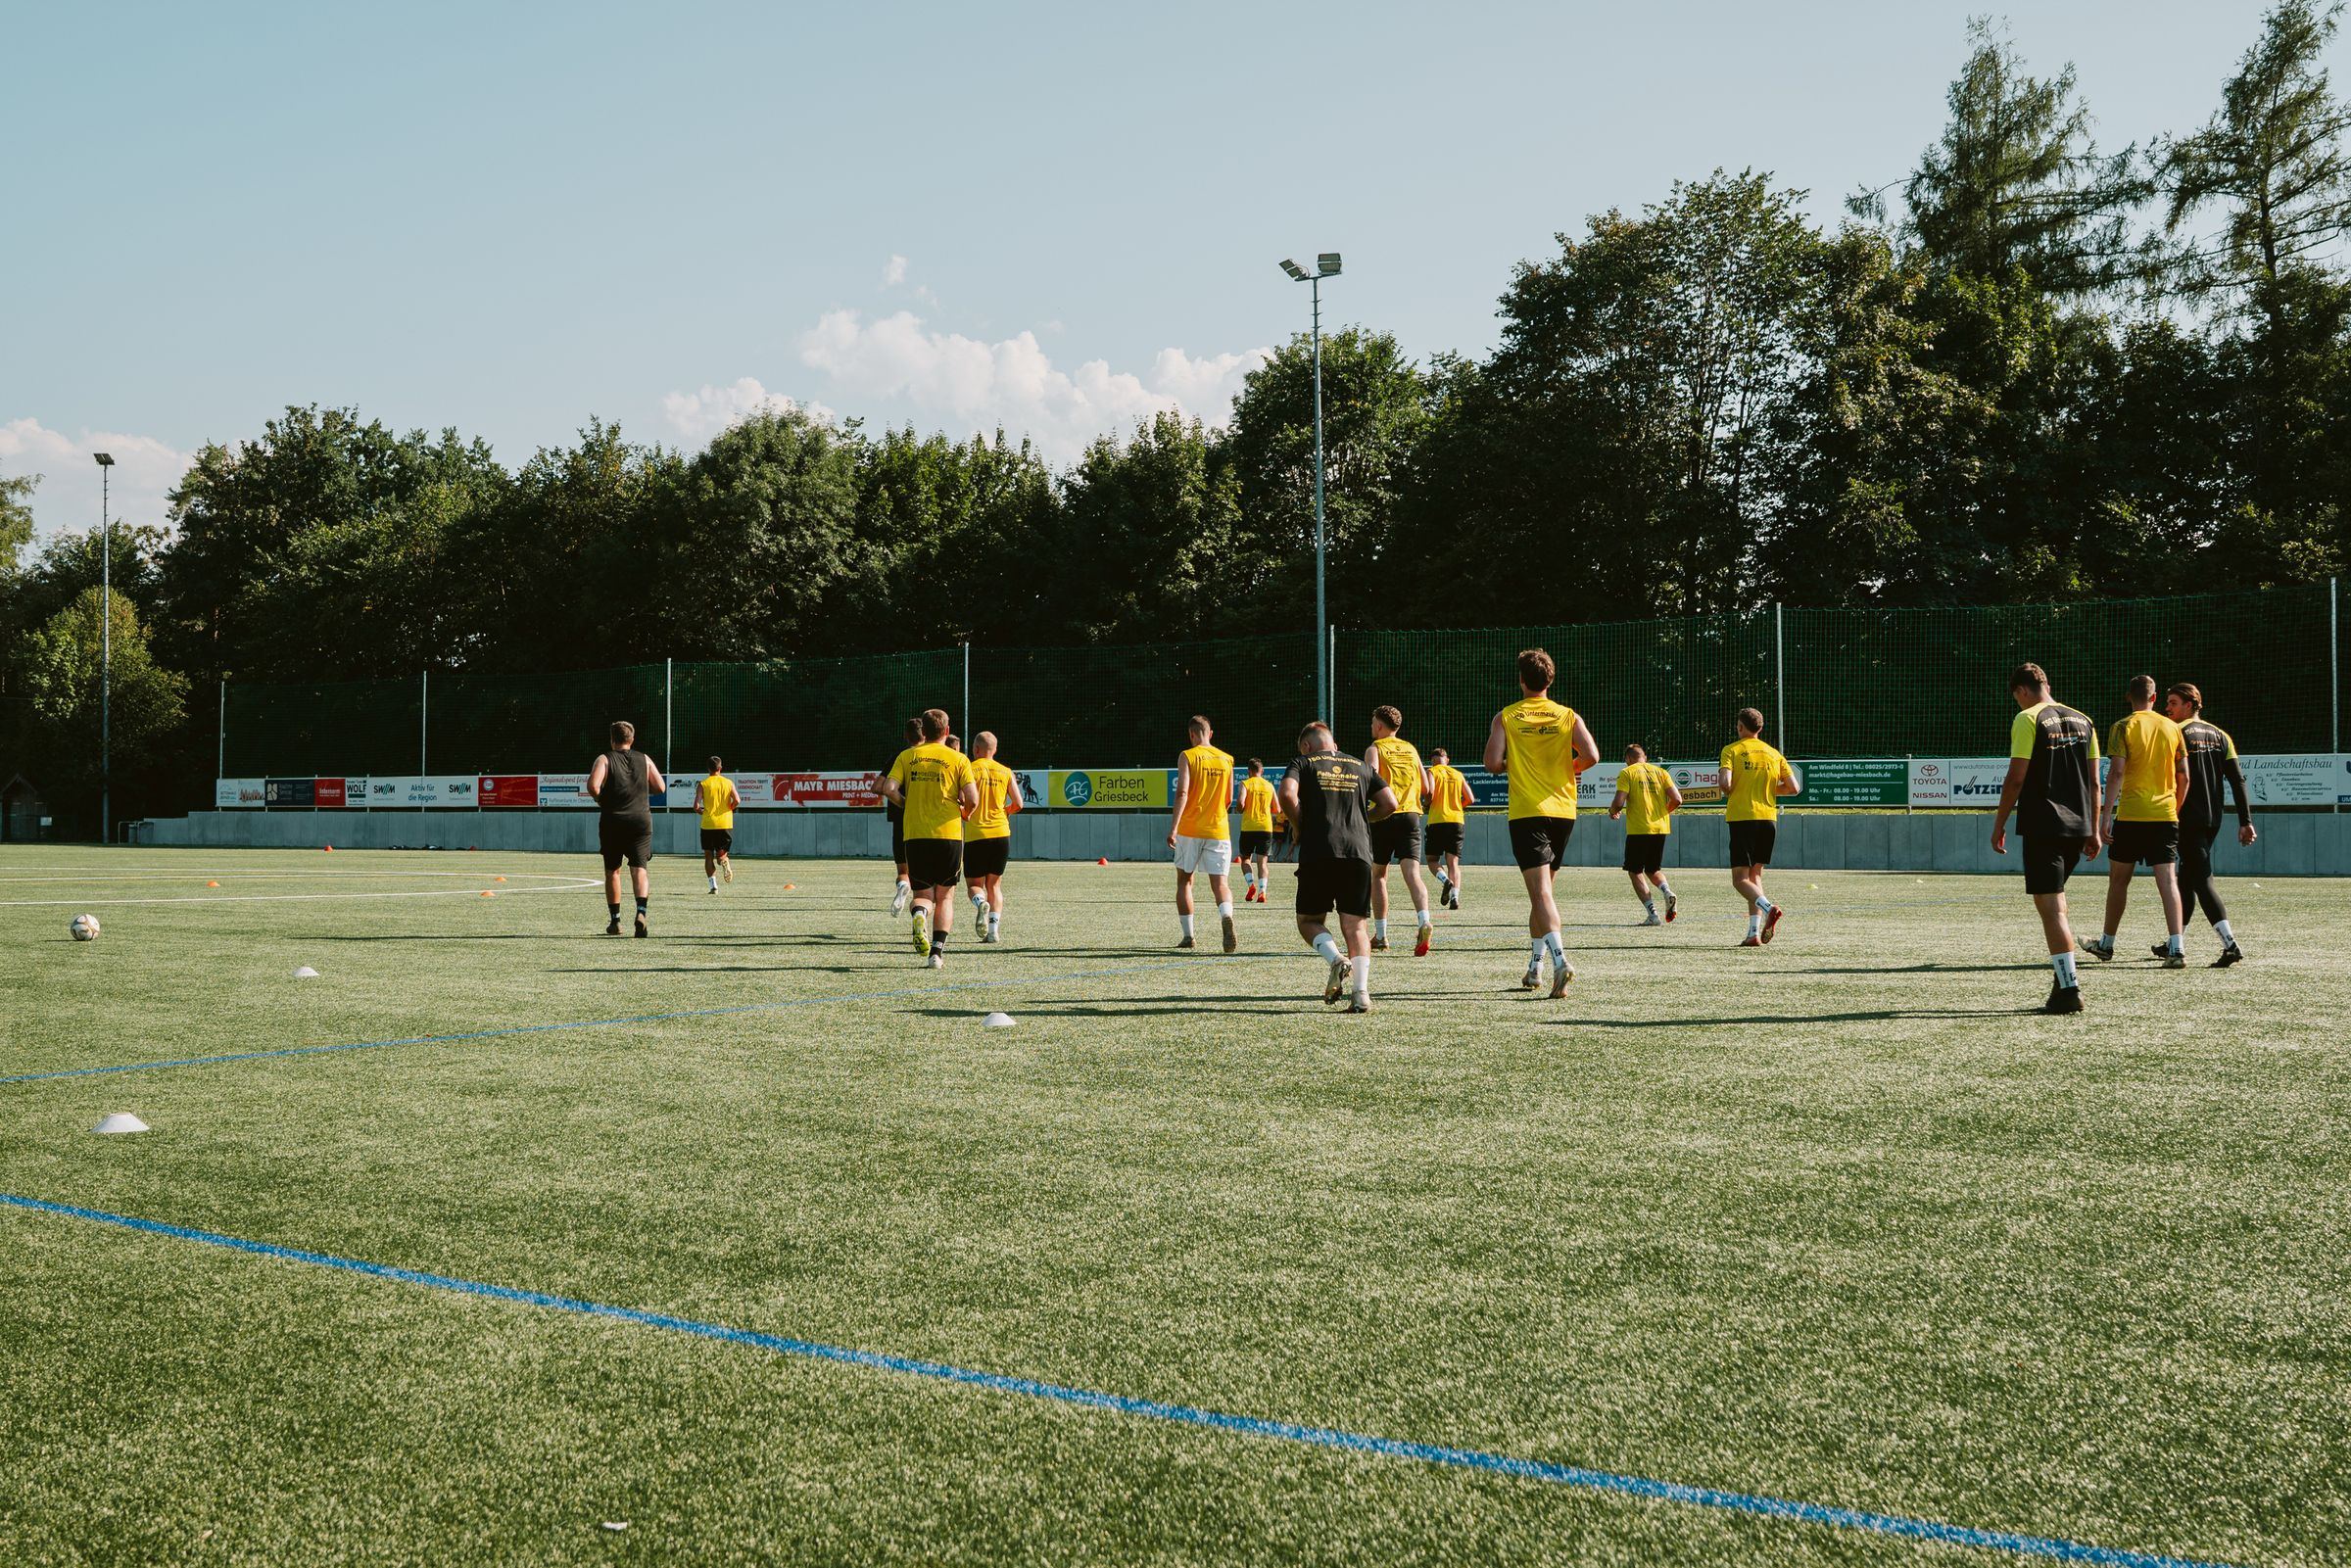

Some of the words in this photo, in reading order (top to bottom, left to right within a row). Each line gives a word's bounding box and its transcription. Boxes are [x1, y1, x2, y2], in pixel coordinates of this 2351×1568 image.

[2254, 758, 2332, 771] Landschaftsbau
[793, 781, 824, 791] MAYR
[1099, 776, 1145, 789] Farben
[346, 784, 367, 793] WOLF
[418, 794, 438, 803] Region
[1094, 791, 1149, 803] Griesbeck
